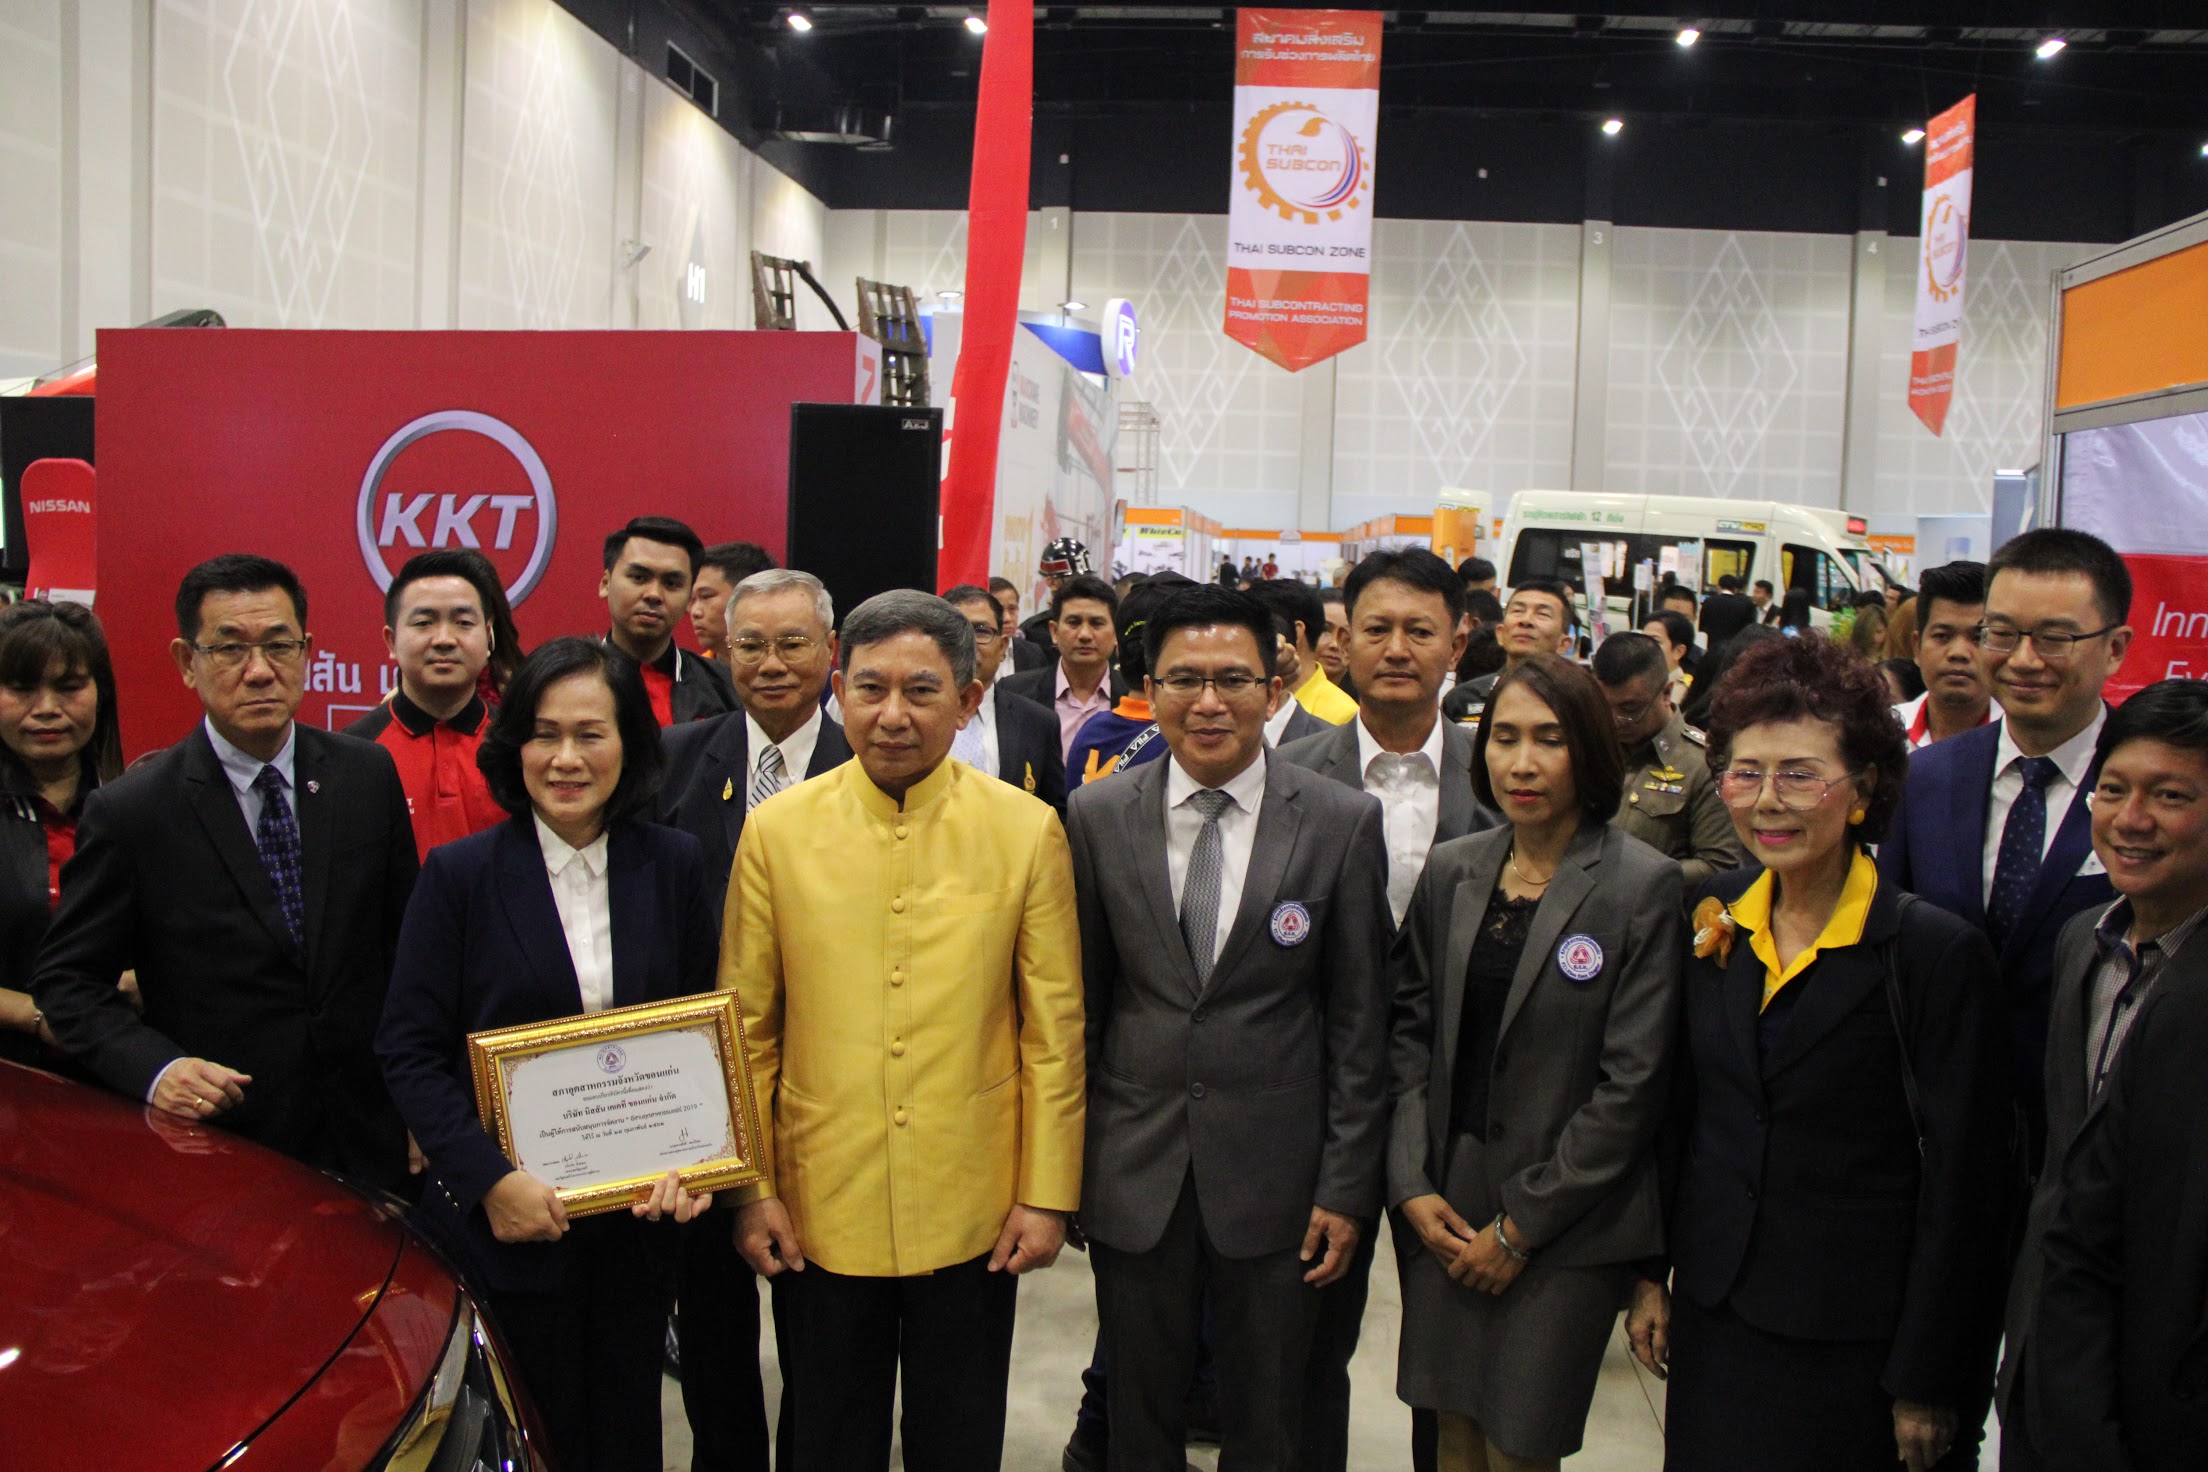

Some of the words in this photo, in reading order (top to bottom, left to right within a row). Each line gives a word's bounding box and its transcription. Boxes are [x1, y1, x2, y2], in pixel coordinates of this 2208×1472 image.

[1266, 143, 1307, 156] THAI
[1593, 231, 1603, 244] 3
[1234, 242, 1264, 254] THAI
[1268, 244, 1325, 257] SUBCON
[1330, 246, 1366, 258] ZONE
[1866, 241, 1878, 254] 4
[687, 262, 706, 304] H1
[1230, 297, 1256, 309] THAI
[1258, 299, 1364, 313] SUBCONTRACTING
[1228, 311, 1288, 323] PROMOTION
[1291, 313, 1363, 326] ASSOCIATION
[29, 498, 91, 514] NISSAN
[378, 492, 534, 550] KKT
[1130, 733, 1149, 750] FILA
[552, 1065, 680, 1098] สภาอุตสาหกรรมจังหวัดขอนแก่น
[562, 1108, 584, 1120] บริษัท
[585, 1103, 606, 1116] นิสสัน
[628, 1094, 658, 1108] ขอนแก่น
[659, 1092, 677, 1103] จำกัด
[683, 1103, 698, 1113] 2019
